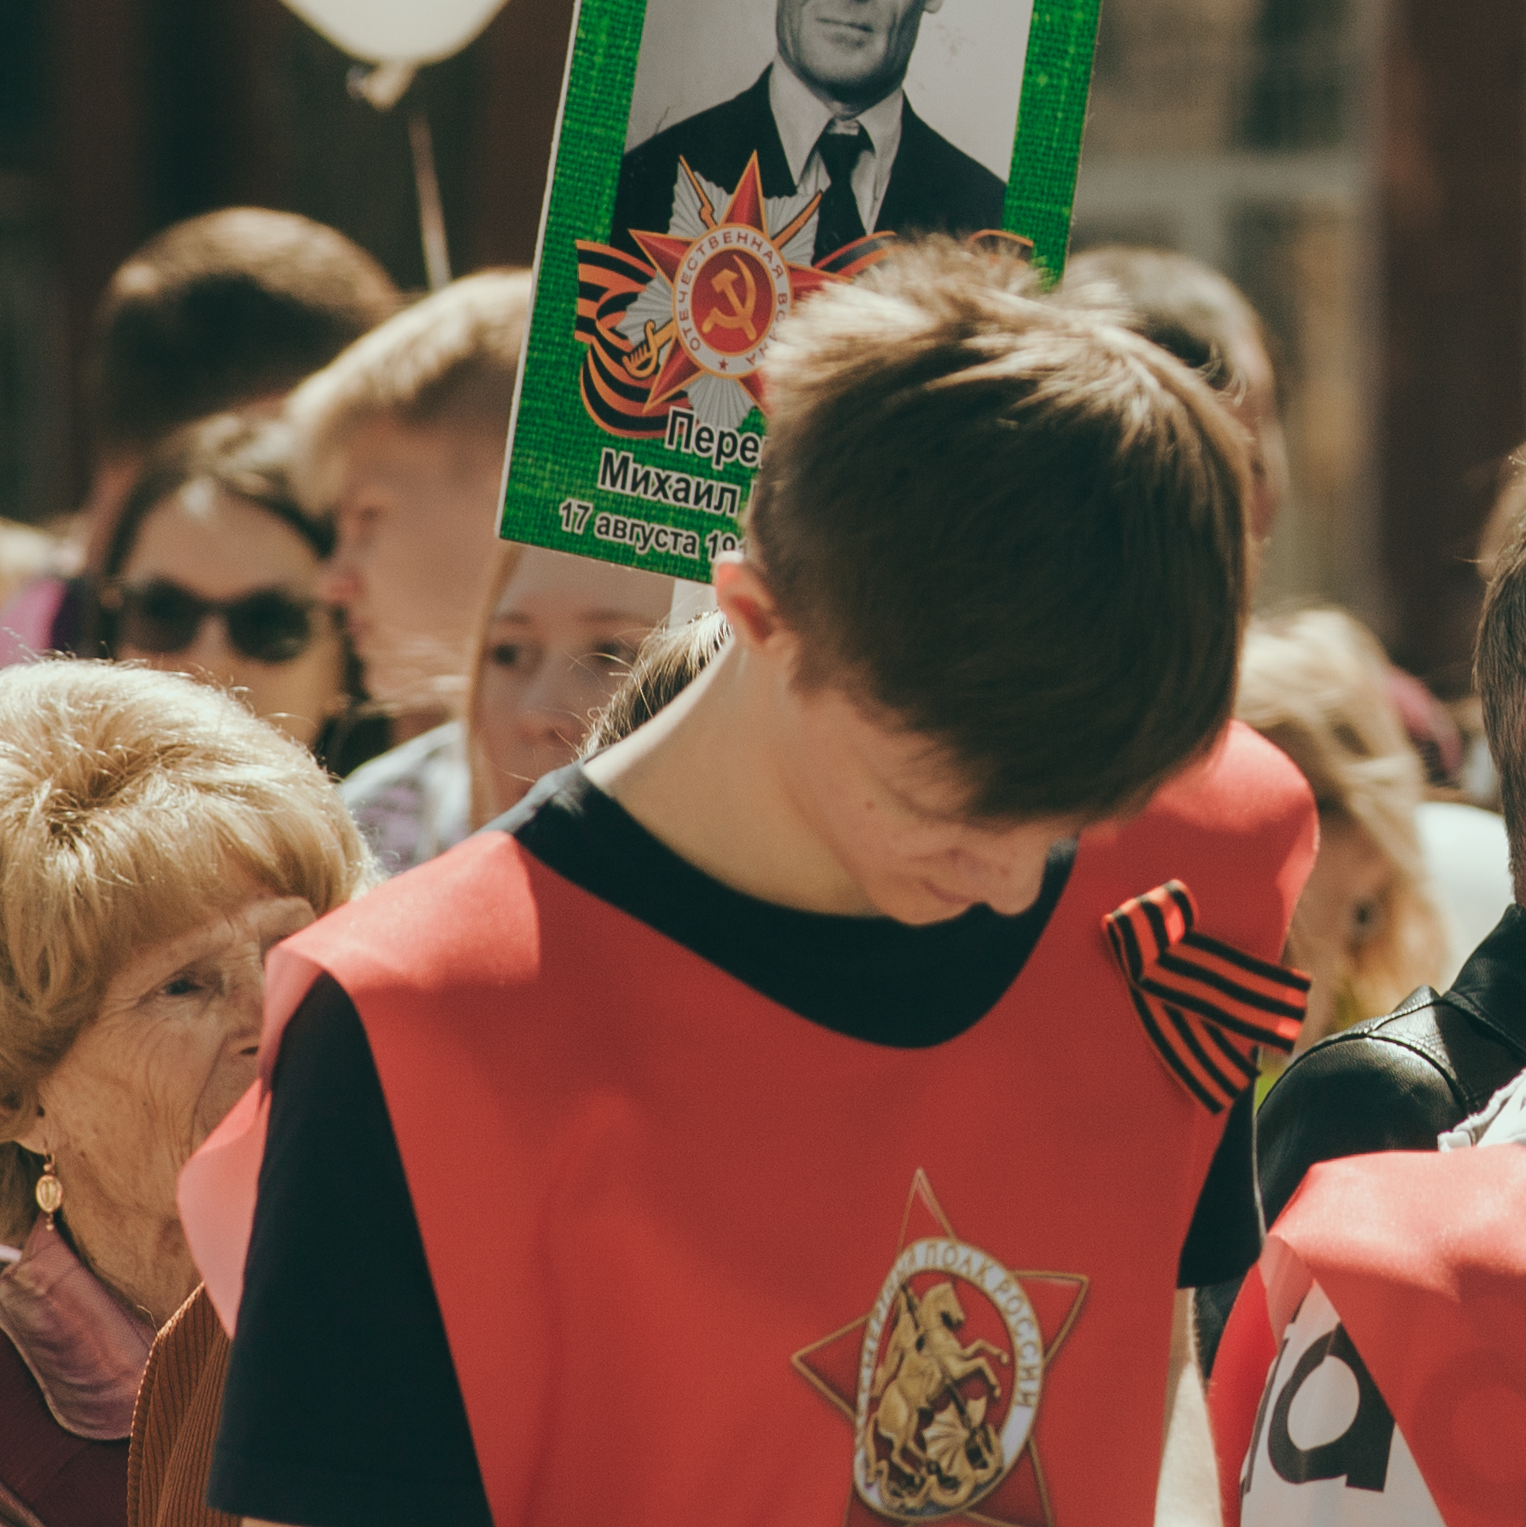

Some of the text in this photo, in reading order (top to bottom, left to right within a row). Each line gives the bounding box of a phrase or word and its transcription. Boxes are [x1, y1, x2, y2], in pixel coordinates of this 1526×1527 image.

[678, 231, 784, 352] ОТЕЧЕСТВЕННАЯ
[665, 406, 764, 470] Пере
[598, 449, 740, 517] Михаил
[560, 497, 593, 535] 17
[593, 511, 700, 560] августа
